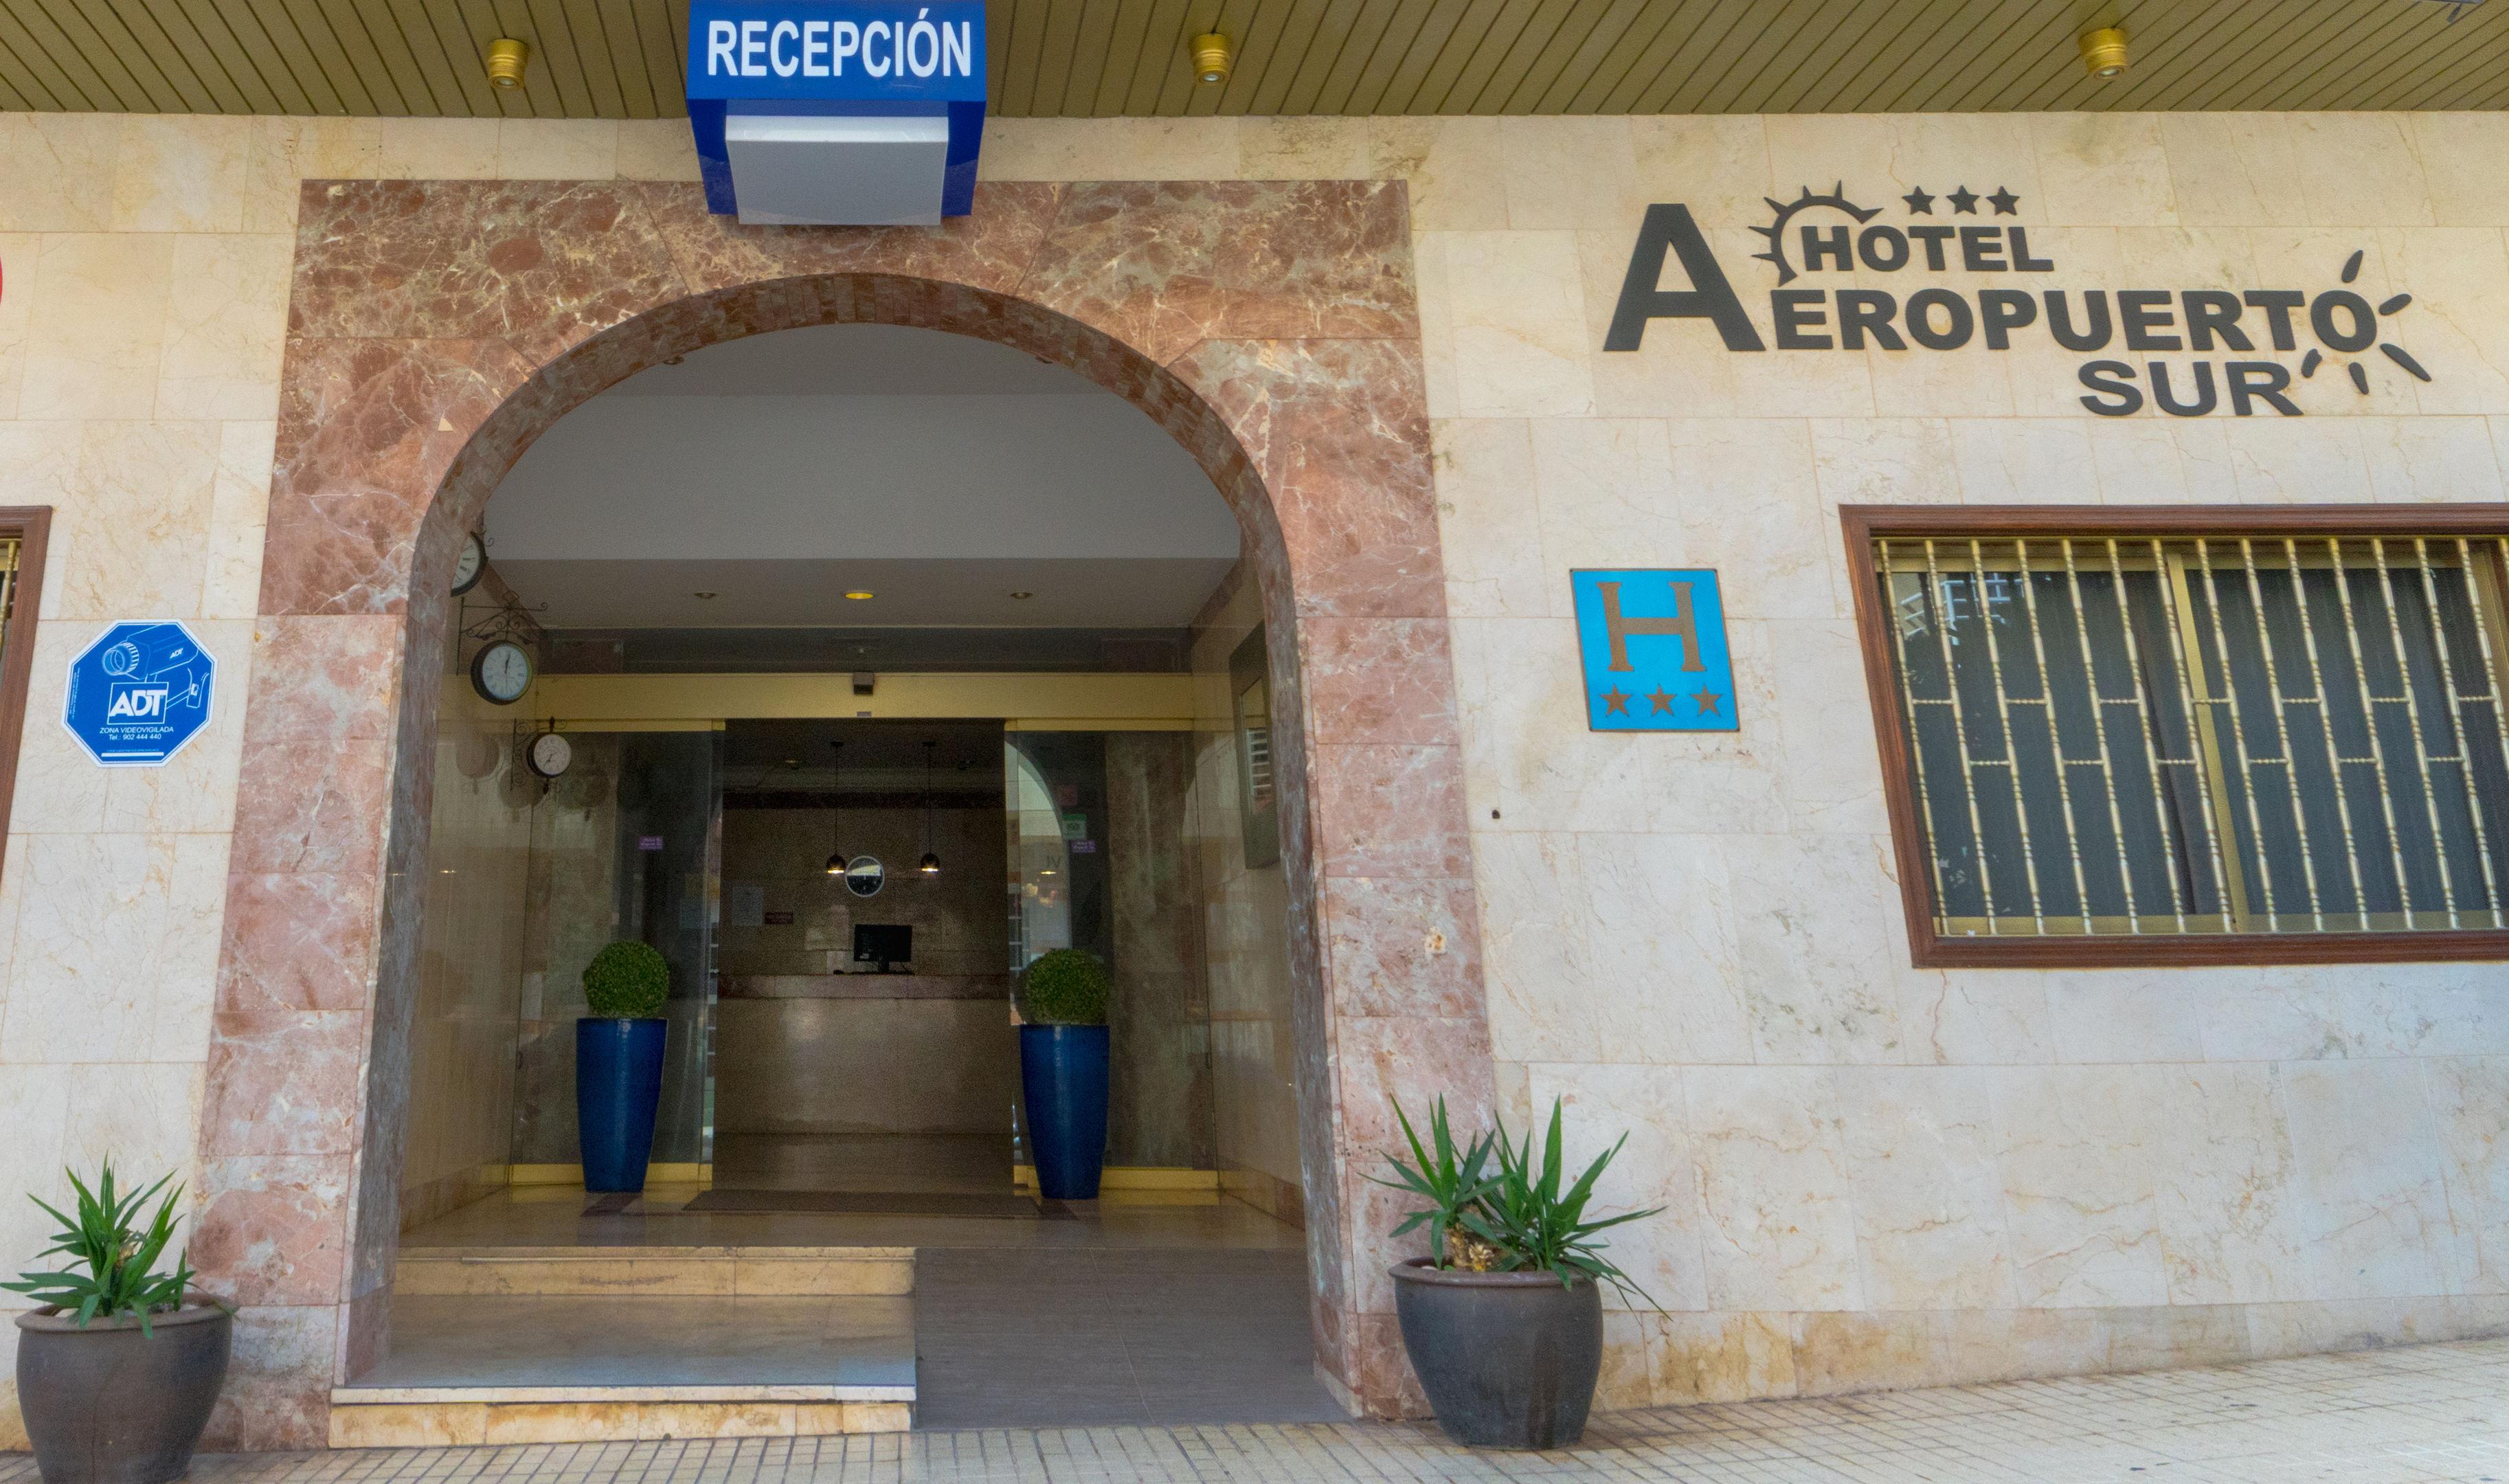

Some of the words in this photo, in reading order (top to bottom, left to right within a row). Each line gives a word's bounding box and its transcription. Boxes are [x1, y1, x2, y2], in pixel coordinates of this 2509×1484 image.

[707, 8, 972, 78] RECEPCIÓN
[1801, 225, 2054, 272] HOTEL
[1603, 203, 2378, 353] AEROPUERTO
[2078, 360, 2304, 417] SUR
[169, 648, 183, 659] ADT
[1596, 581, 1707, 672] H
[109, 689, 168, 717] ADT
